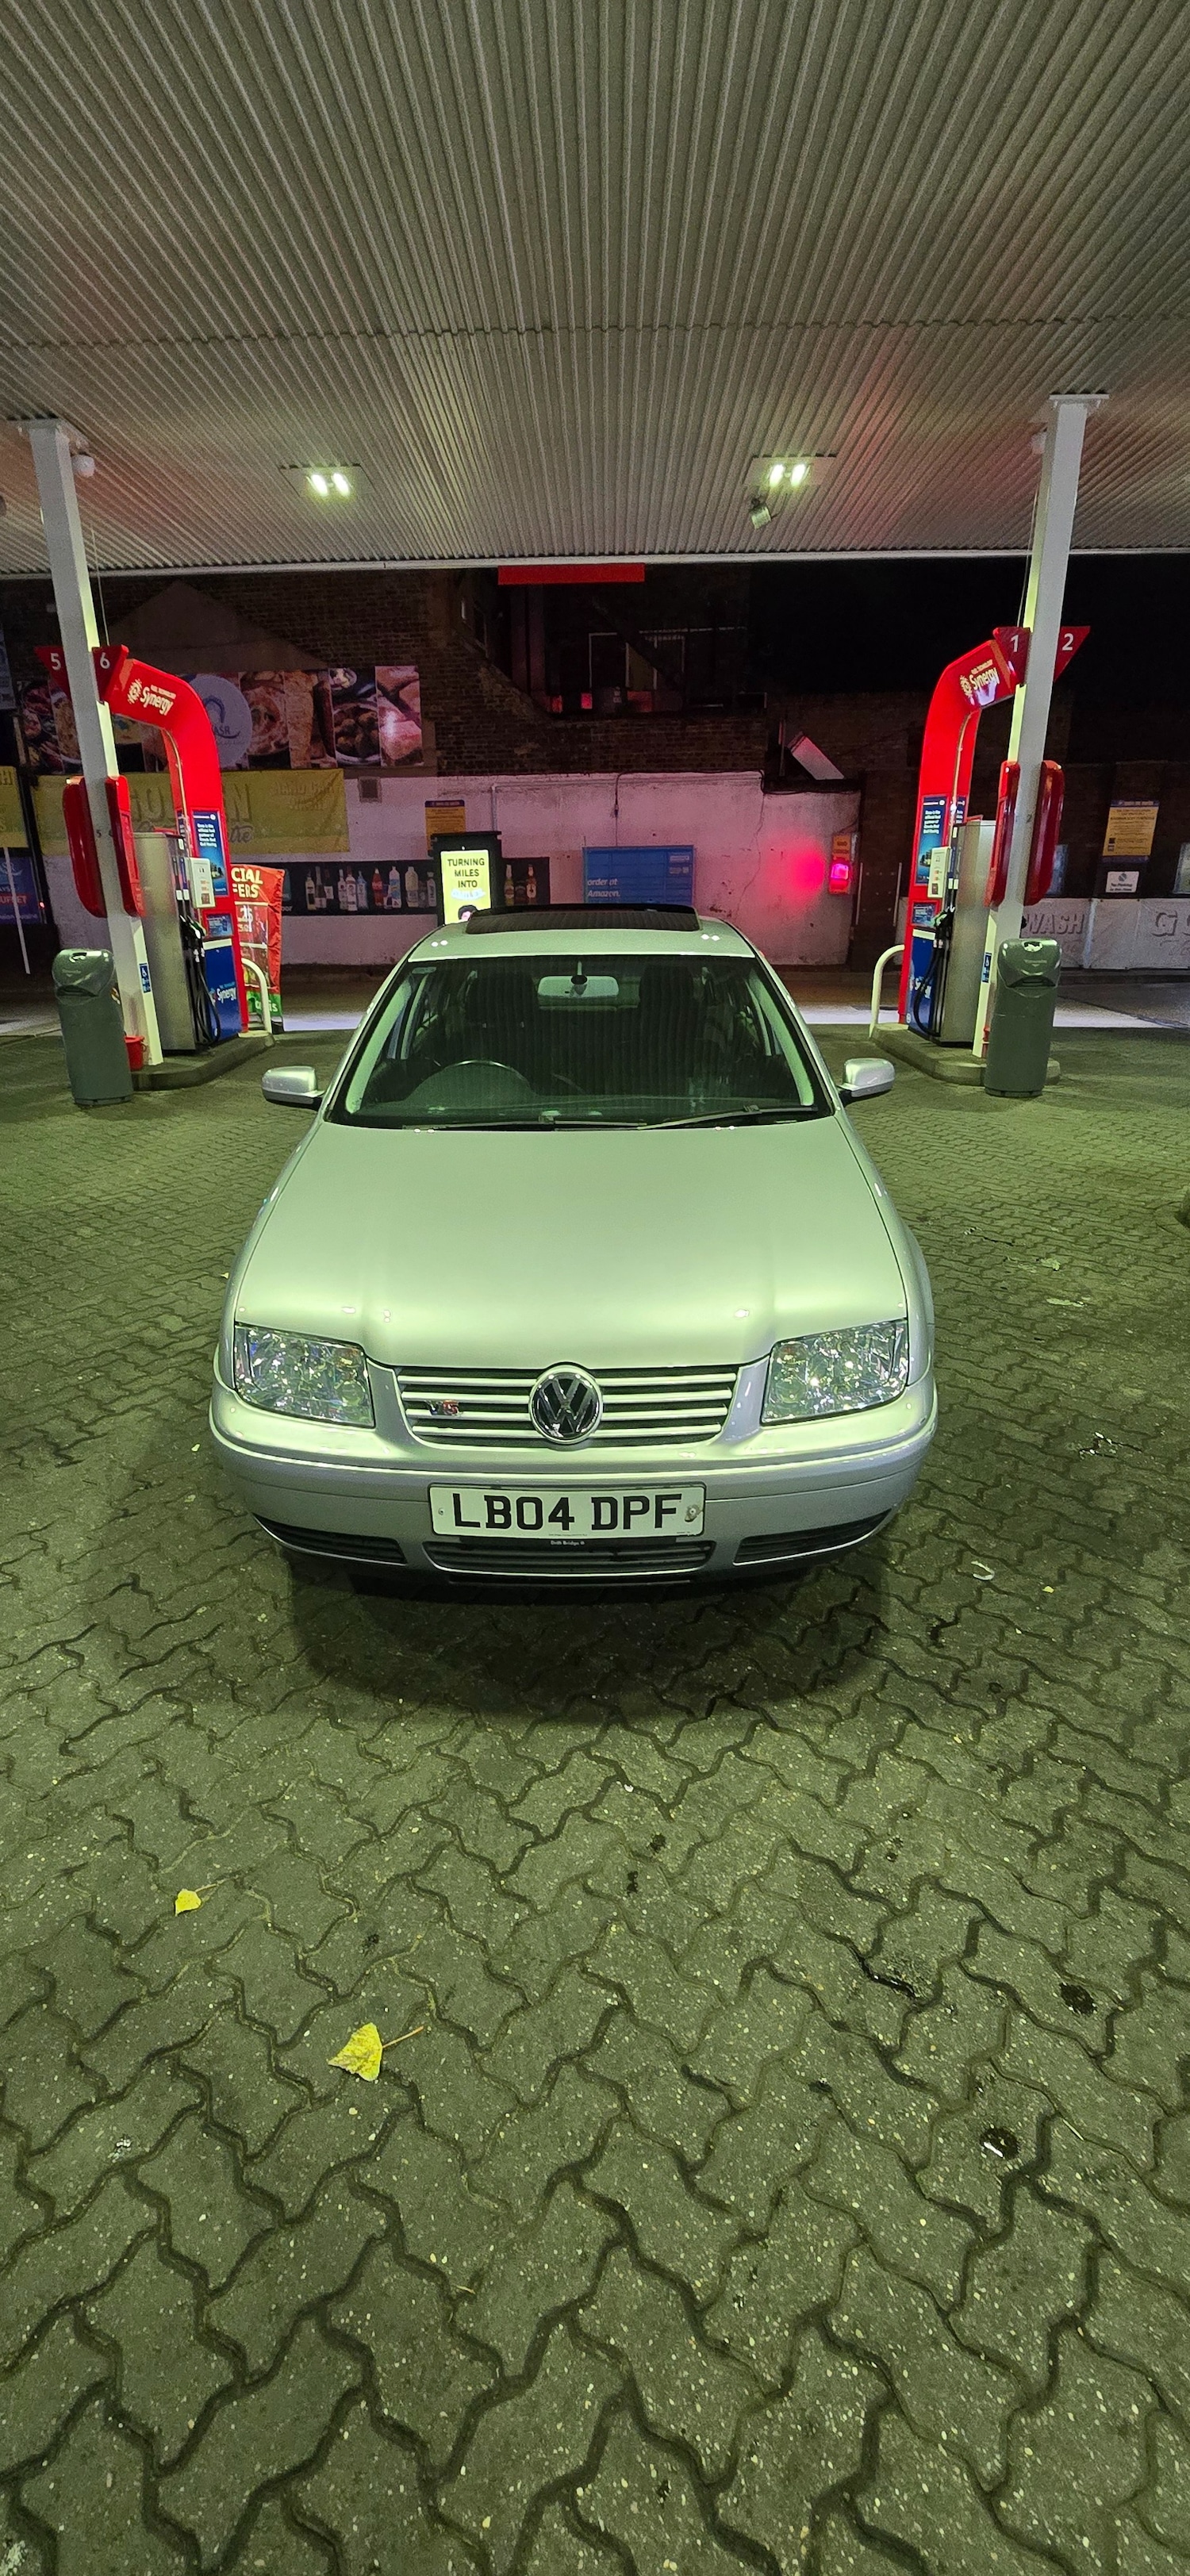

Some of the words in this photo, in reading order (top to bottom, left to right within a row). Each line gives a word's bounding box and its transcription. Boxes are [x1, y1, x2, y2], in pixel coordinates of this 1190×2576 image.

[1010, 635, 1019, 652] 1
[1061, 633, 1074, 651] 2
[50, 653, 61, 670] 5
[100, 652, 110, 669] 6
[969, 667, 1000, 690] Synergy
[140, 686, 174, 716] Synergy
[231, 867, 263, 885] CIAL
[232, 882, 259, 898] ERS
[452, 1492, 575, 1530] LB04
[591, 1493, 683, 1530] DPF
